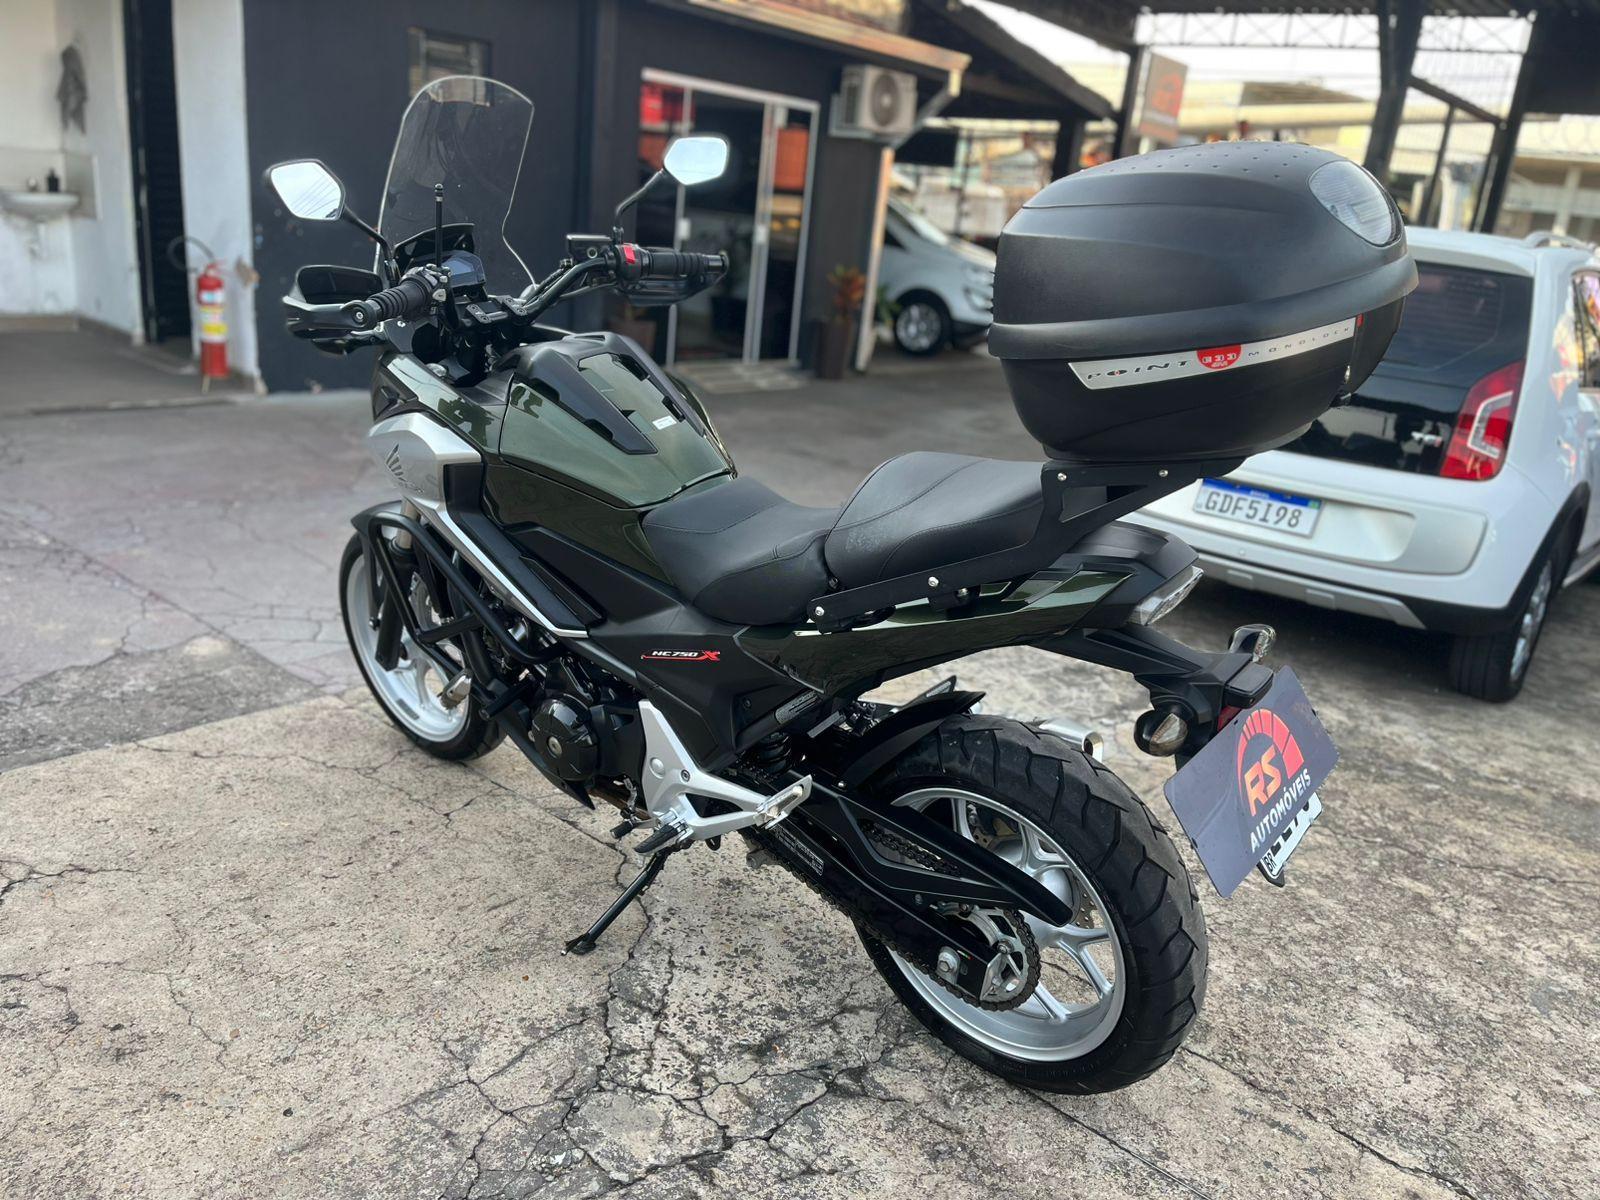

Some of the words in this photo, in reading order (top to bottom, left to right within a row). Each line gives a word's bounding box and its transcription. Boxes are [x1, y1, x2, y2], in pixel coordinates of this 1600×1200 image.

[1204, 490, 1302, 529] GDF5I98
[1244, 745, 1282, 817] RS
[1249, 767, 1312, 853] AUTOMÓVEIS
